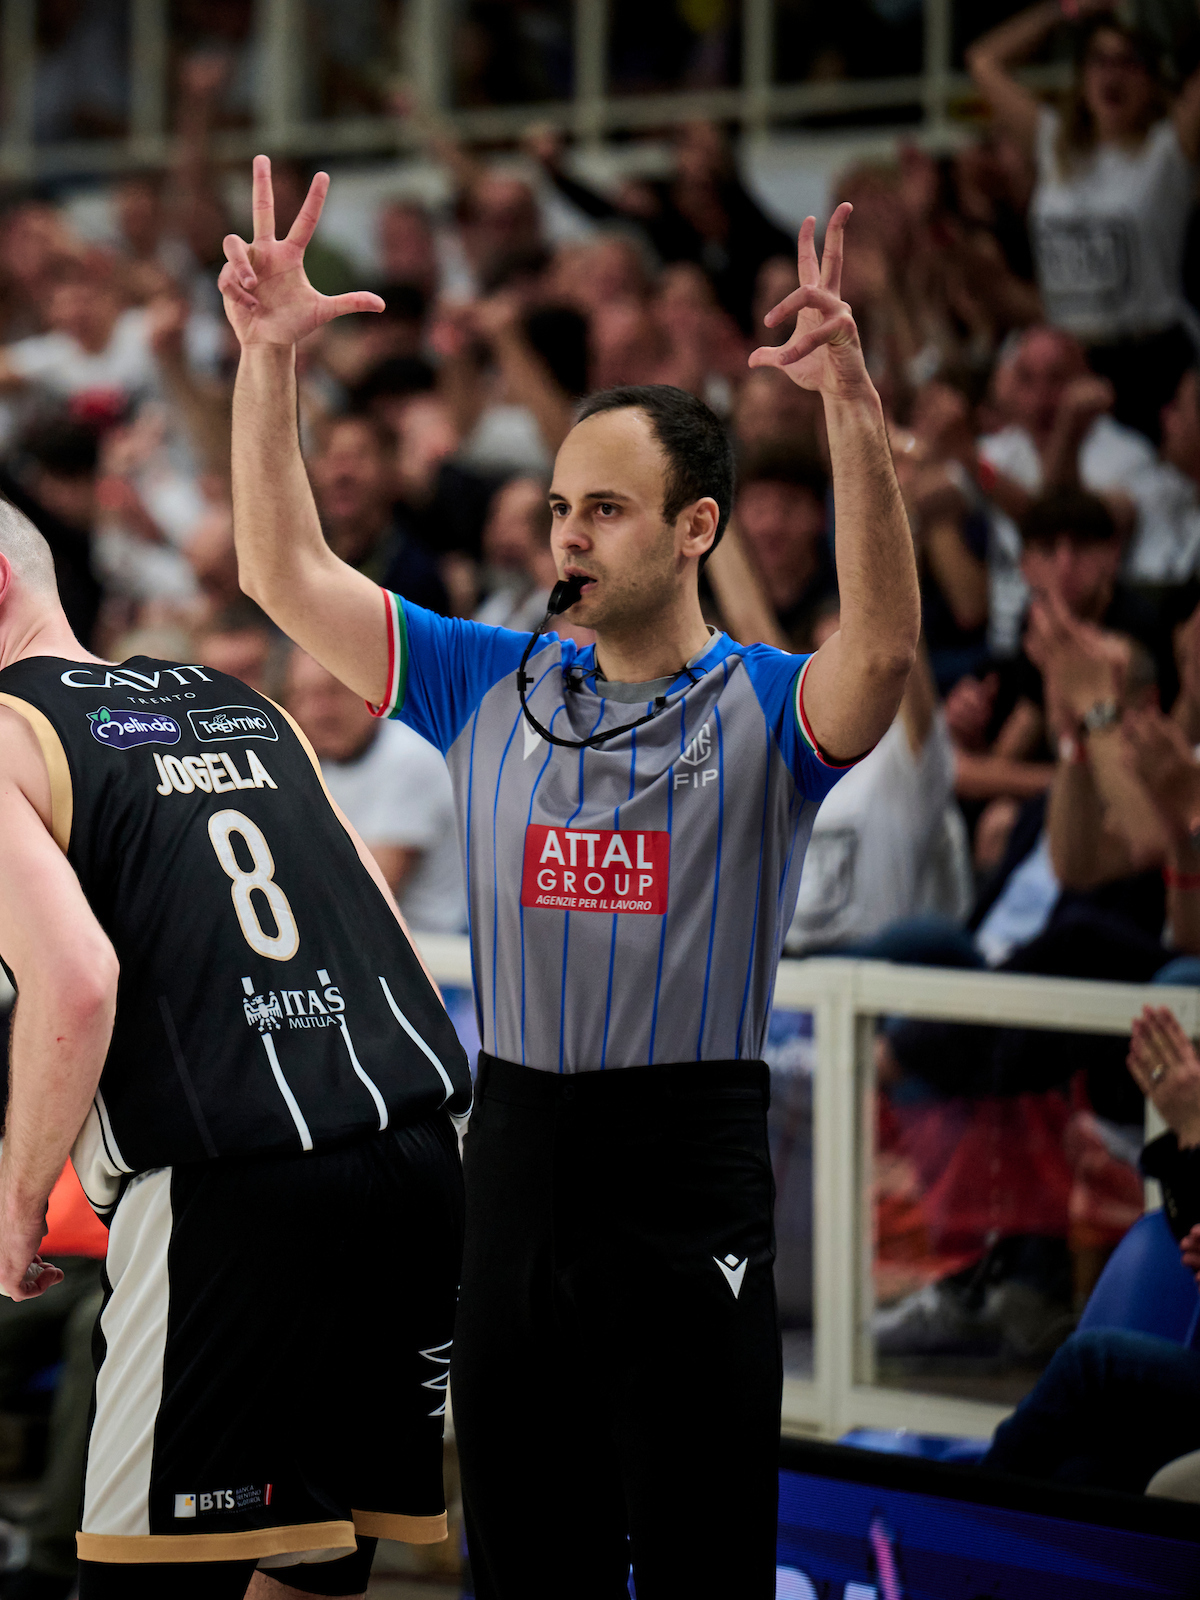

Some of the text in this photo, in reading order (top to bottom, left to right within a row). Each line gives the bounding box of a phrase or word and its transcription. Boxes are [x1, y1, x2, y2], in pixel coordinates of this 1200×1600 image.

[60, 665, 213, 693] CAVIT
[127, 692, 196, 705] TRENTO
[97, 717, 176, 738] Melinda
[199, 715, 267, 735] TRENTINO
[153, 749, 278, 796] JOGELA
[673, 769, 719, 790] FIP
[539, 830, 653, 870] ATTAL
[207, 809, 300, 962] 8
[537, 868, 653, 896] GROUP
[535, 895, 652, 911] AGENZIE PER IL LAVORO
[280, 986, 346, 1016] ITAS
[288, 1015, 337, 1029] MUTUA
[200, 1490, 235, 1511] BTS
